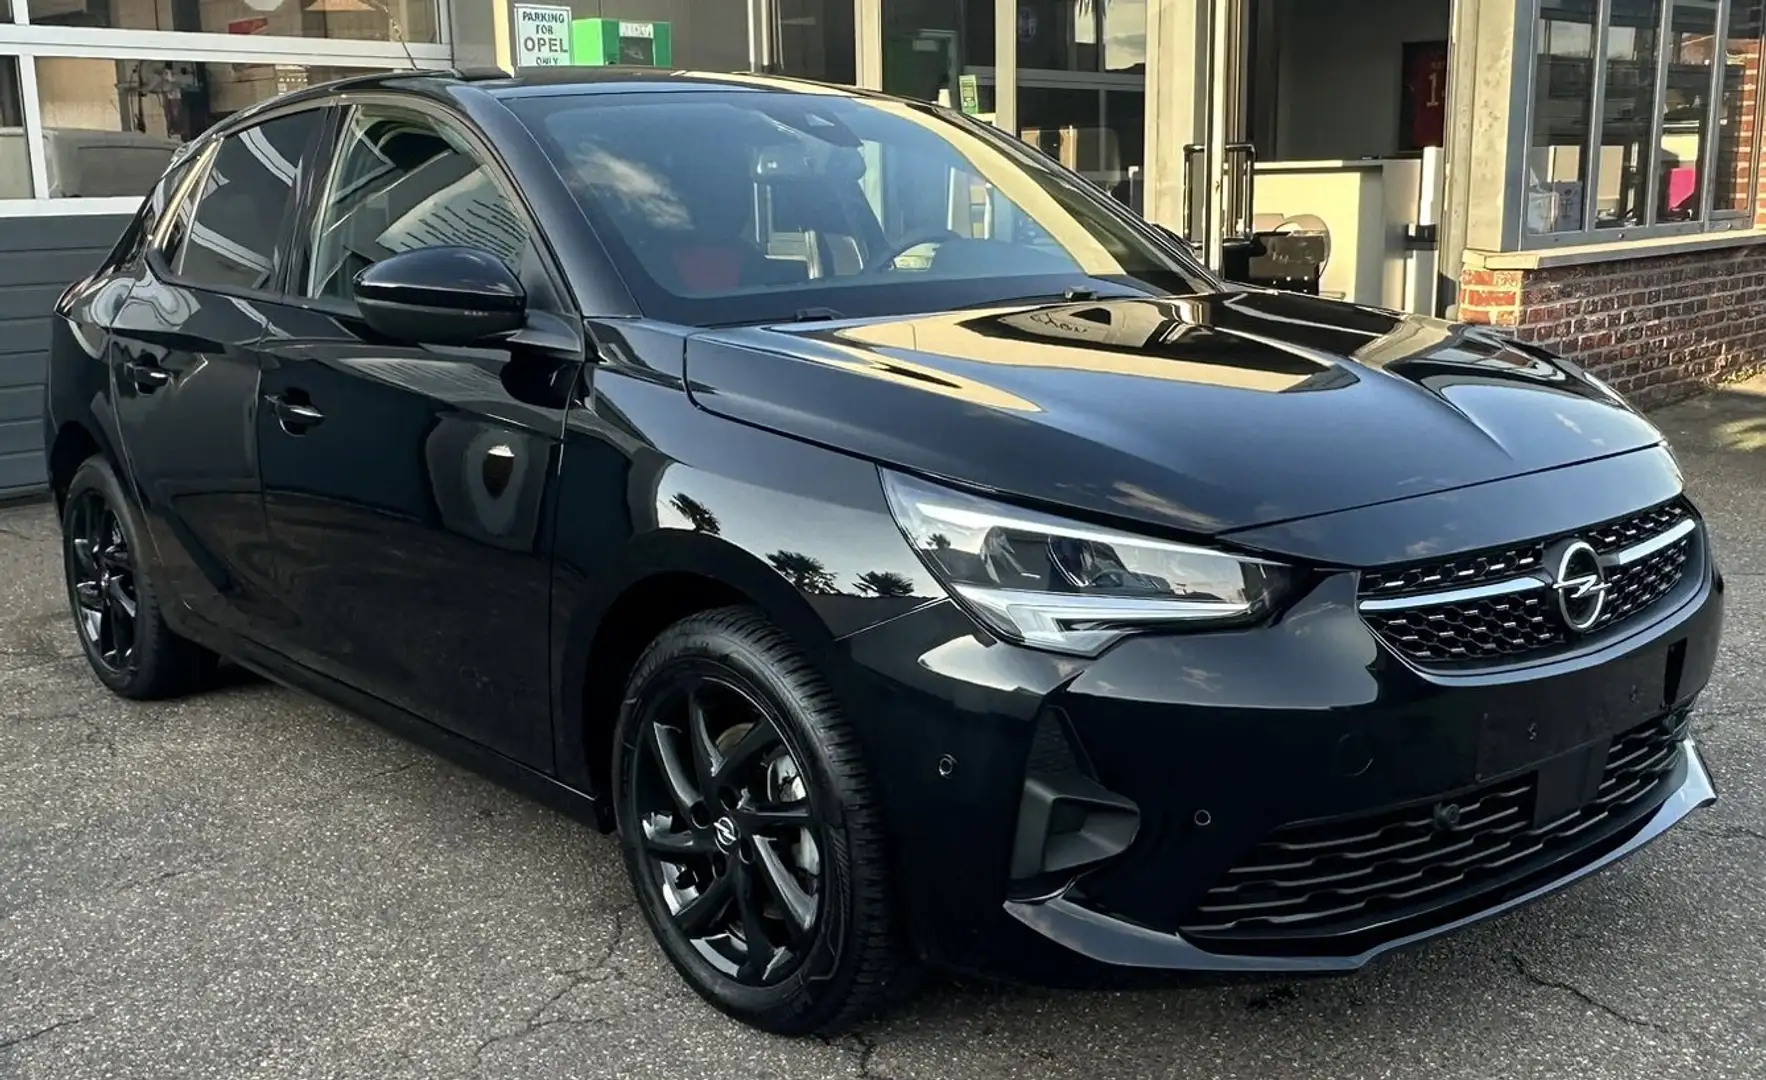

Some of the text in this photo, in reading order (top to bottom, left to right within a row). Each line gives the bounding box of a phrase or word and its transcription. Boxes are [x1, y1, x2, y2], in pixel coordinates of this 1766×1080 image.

[523, 11, 565, 23] PARKING
[536, 24, 554, 35] FOR
[524, 37, 569, 53] OPEL
[1426, 72, 1445, 108] 1
